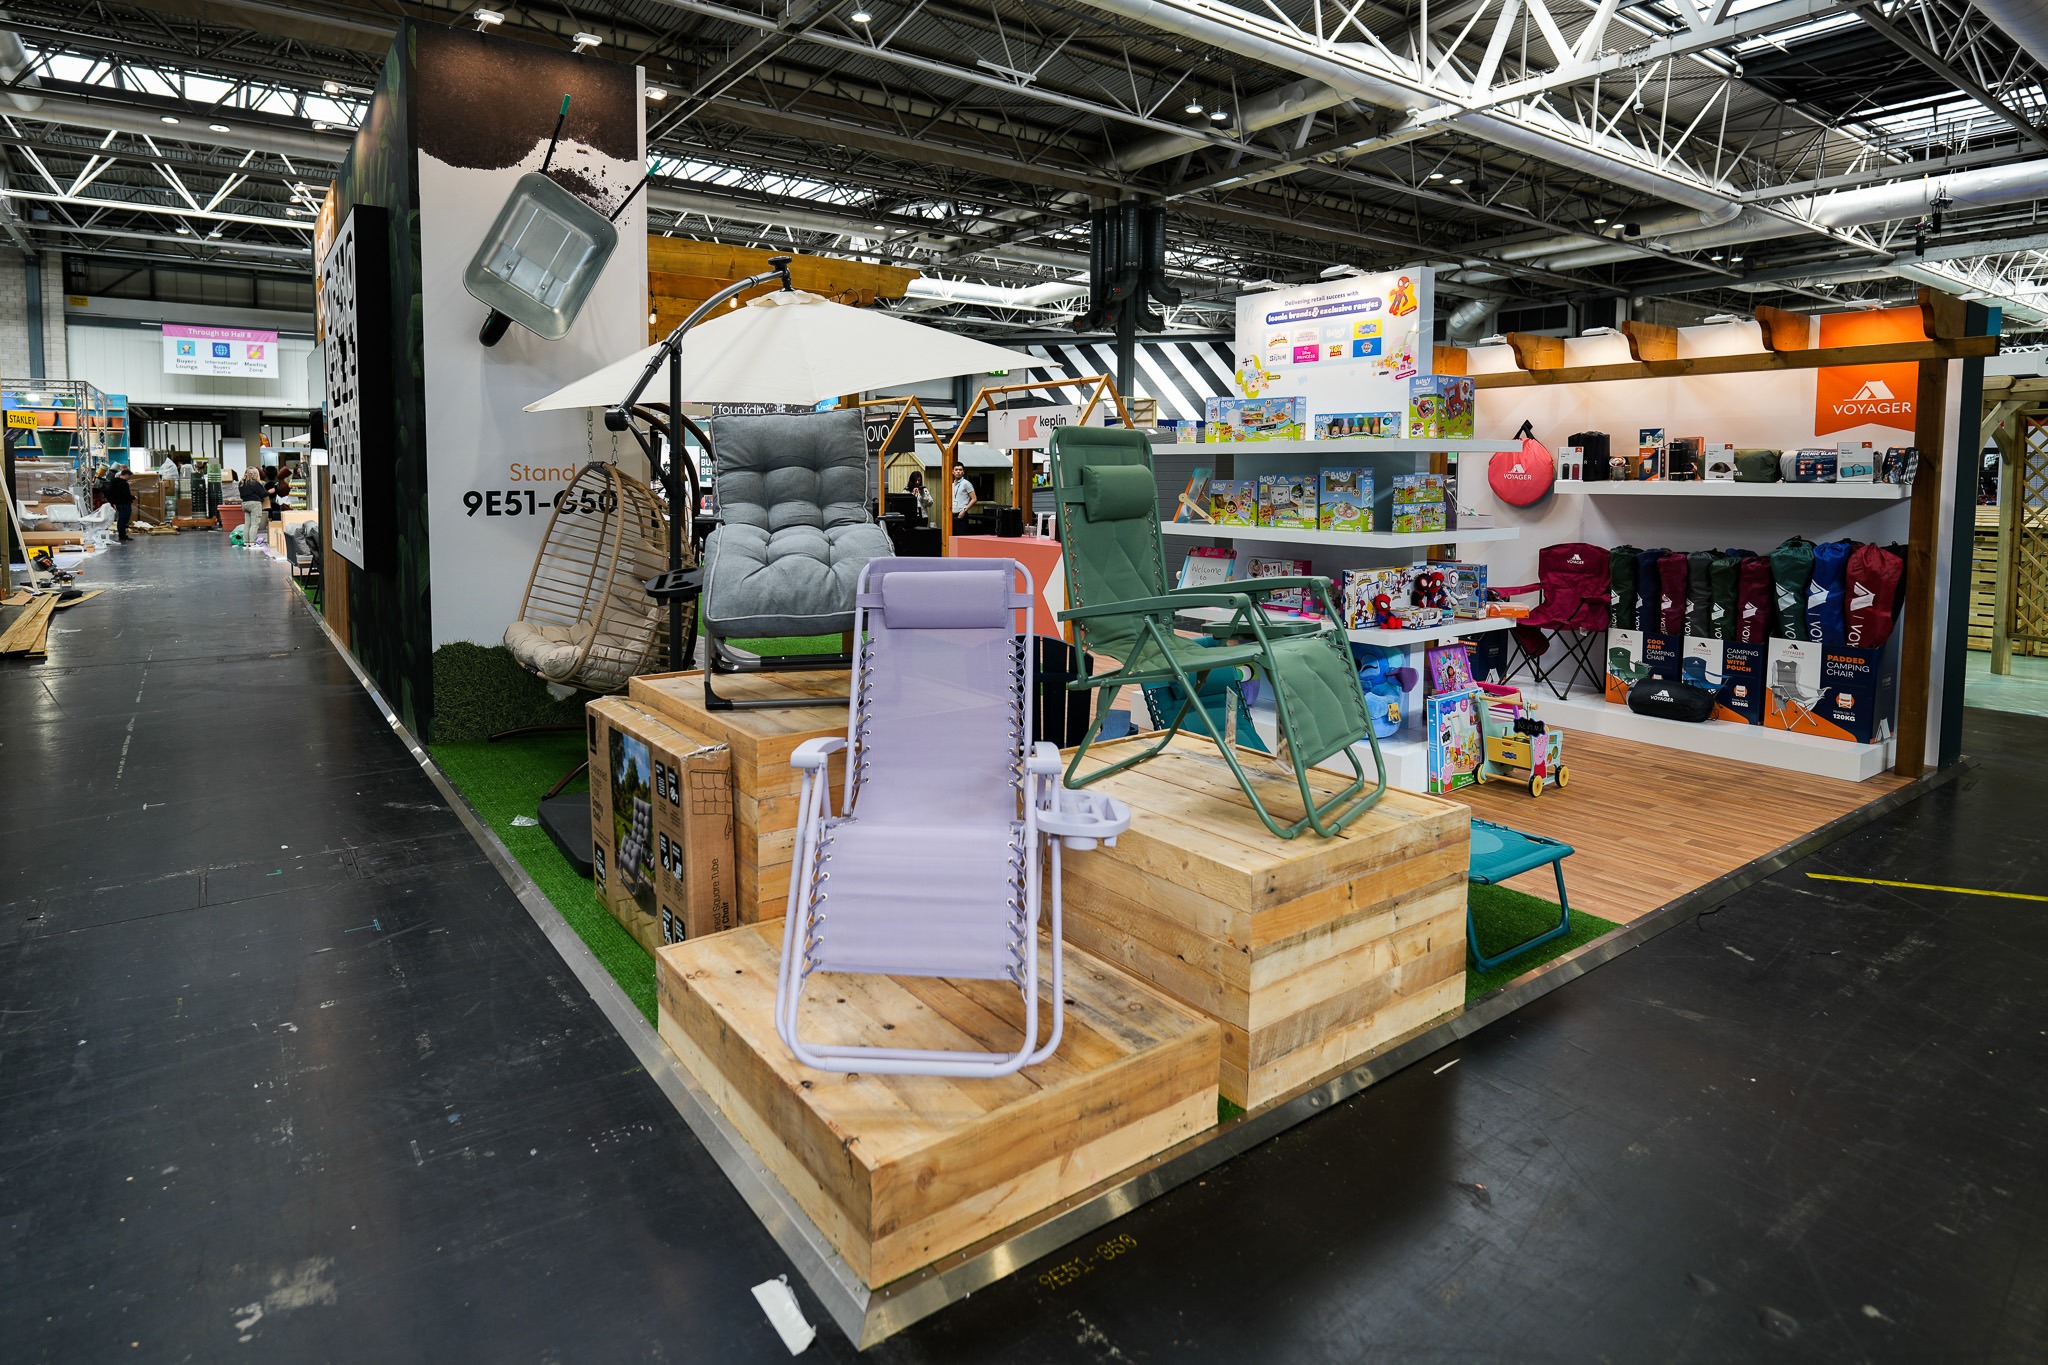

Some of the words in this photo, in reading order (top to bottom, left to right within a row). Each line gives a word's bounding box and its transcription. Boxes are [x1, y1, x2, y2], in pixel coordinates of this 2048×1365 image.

[1289, 310, 1311, 319] brands
[1312, 306, 1319, 317] &
[1320, 304, 1352, 314] exclusive
[1353, 301, 1378, 312] ranges
[187, 328, 220, 337] Through
[718, 403, 766, 415] fountain
[1832, 402, 1912, 416] VOYAGER
[9, 414, 36, 424] STANLEY
[1039, 414, 1067, 429] keplin
[510, 462, 576, 482] Stand
[462, 489, 618, 518] 9E51-G50
[1192, 564, 1222, 576] Welcome
[1647, 638, 1665, 646] COOL
[1646, 649, 1675, 657] CAMPING
[1726, 648, 1759, 656] CAMPING
[1827, 654, 1865, 664] PADDED
[1826, 661, 1870, 673] CAMPING
[1826, 669, 1854, 678] CHAIR
[1650, 695, 1674, 703] VOYAGER
[1833, 714, 1856, 722] 120KG
[712, 882, 721, 912] Square
[722, 902, 730, 924] Chair
